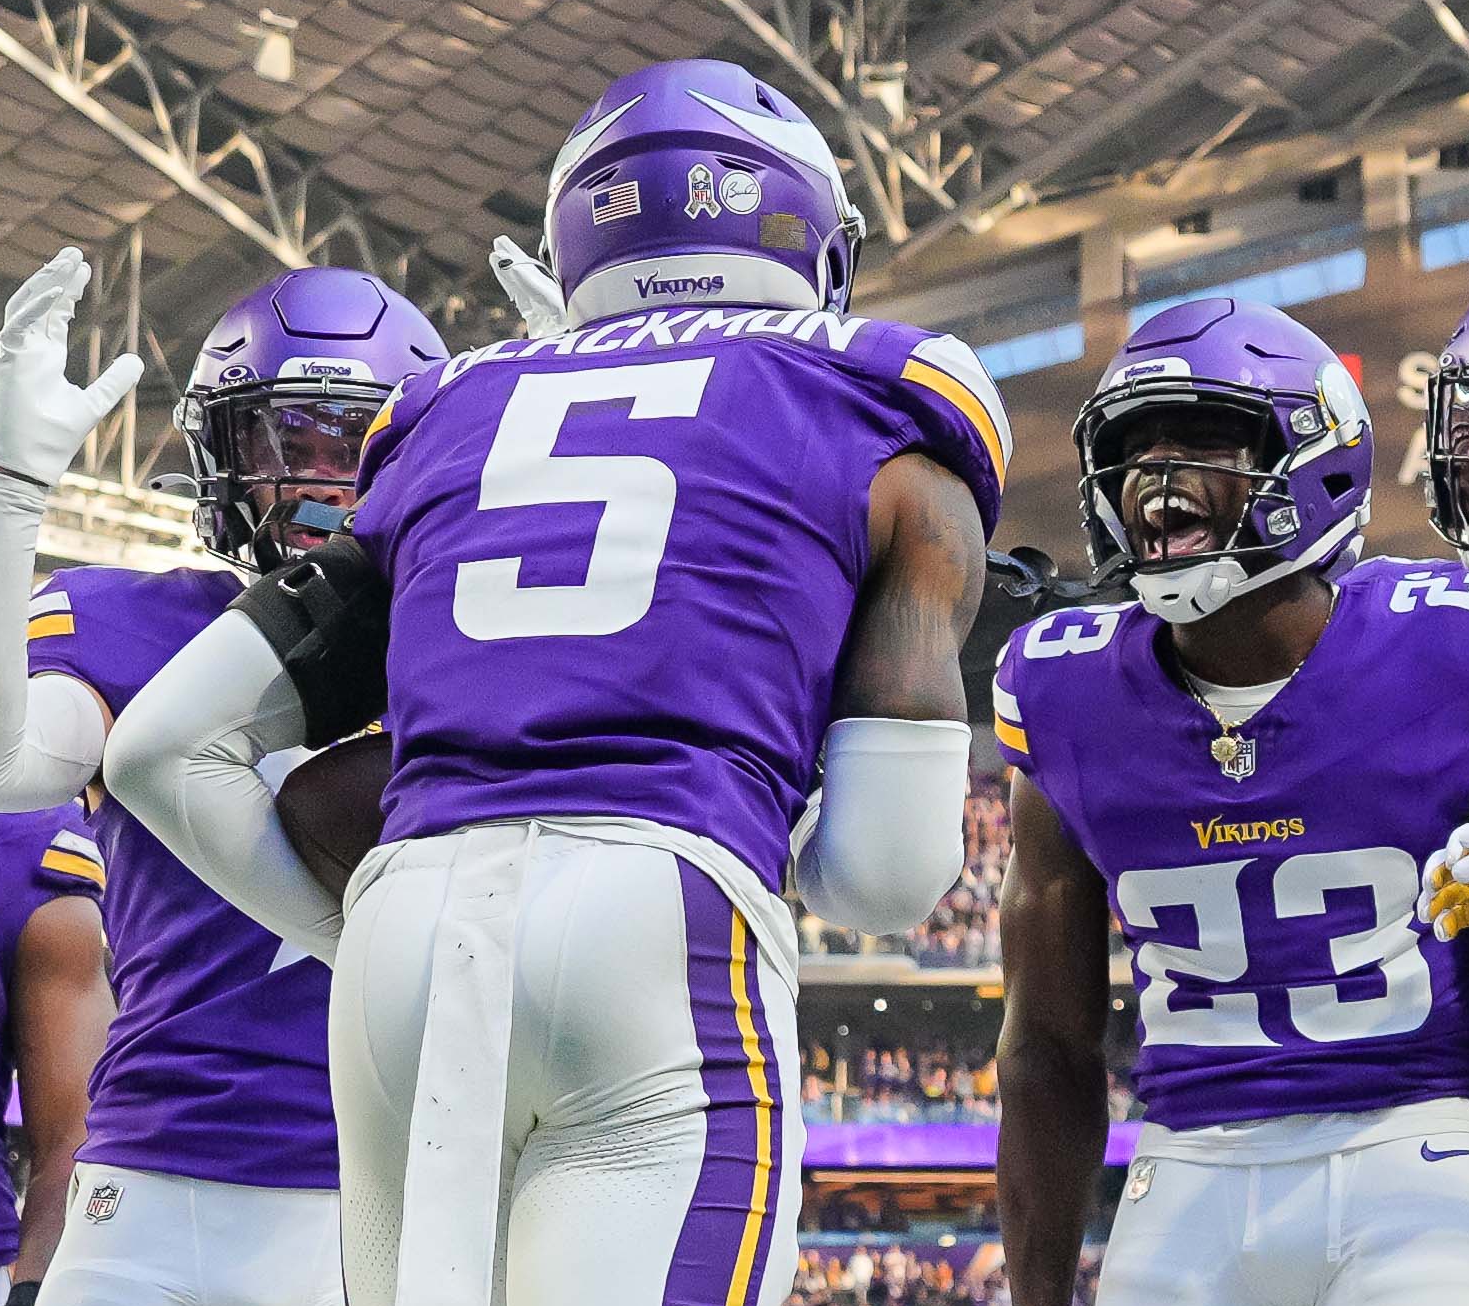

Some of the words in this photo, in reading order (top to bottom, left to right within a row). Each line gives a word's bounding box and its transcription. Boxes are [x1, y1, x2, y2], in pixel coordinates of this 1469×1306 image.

[452, 356, 716, 642] 5
[1116, 846, 1433, 1048] 23
[87, 1198, 115, 1216] NFL
